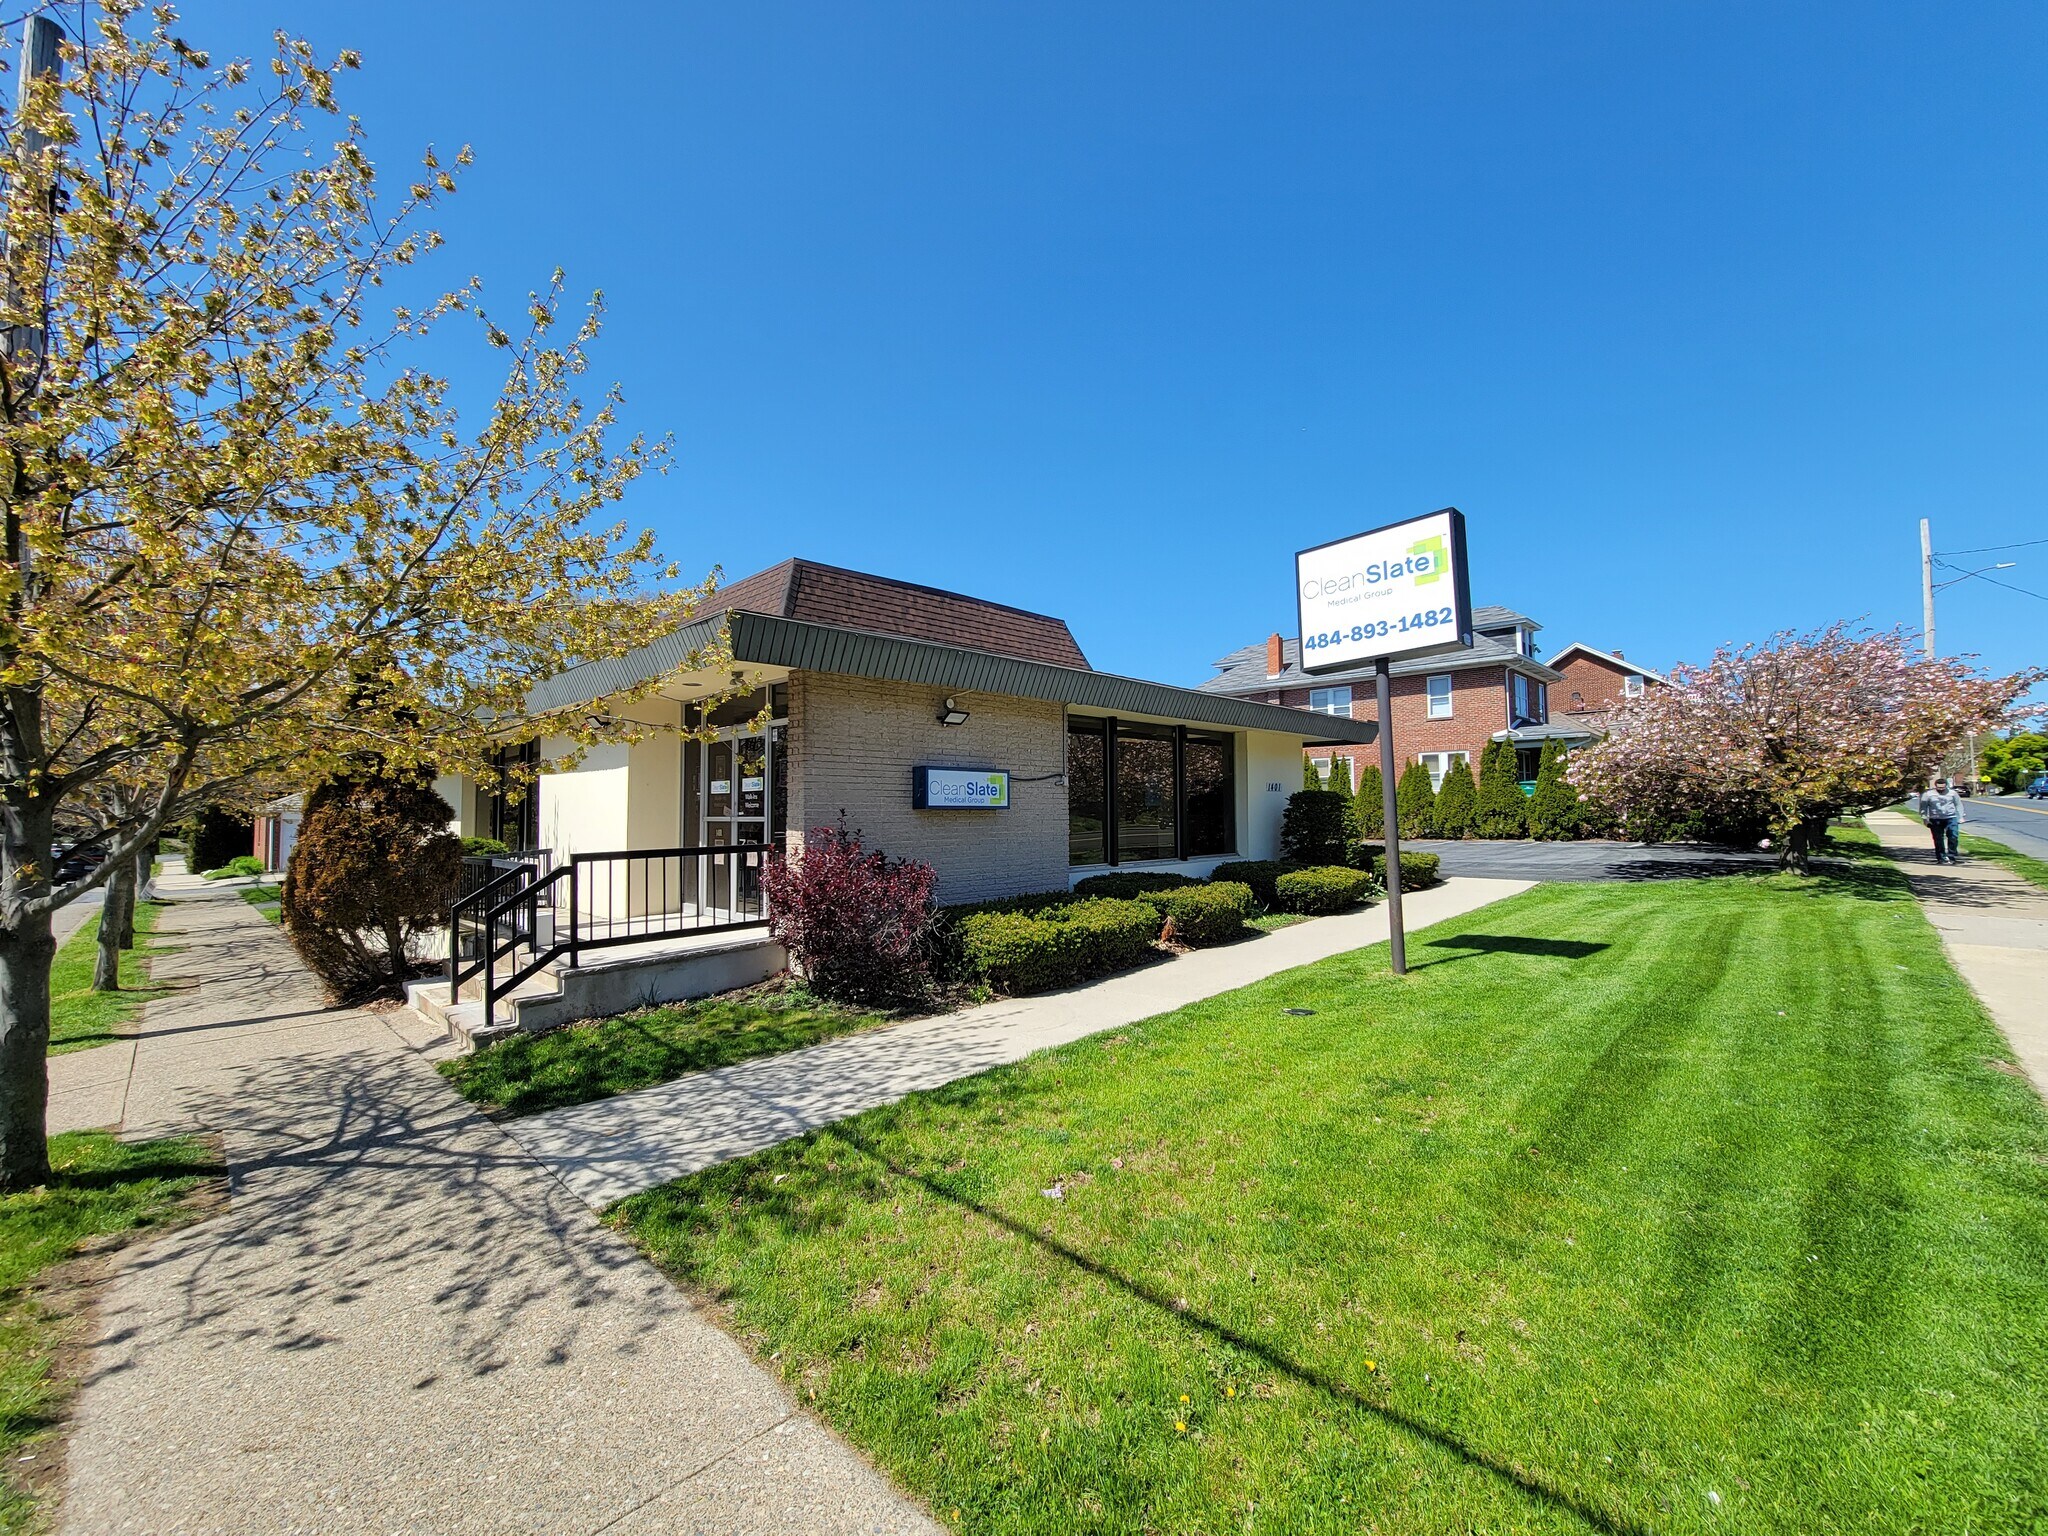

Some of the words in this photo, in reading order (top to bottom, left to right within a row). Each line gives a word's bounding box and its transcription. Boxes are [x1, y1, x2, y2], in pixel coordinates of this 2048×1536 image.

[1303, 556, 1430, 600] CleanSlate
[1327, 595, 1361, 608] Medical
[1364, 587, 1393, 601] Group
[1304, 607, 1454, 650] 484-893-1482
[929, 780, 998, 796] CleanSlate
[944, 796, 967, 804] Medical
